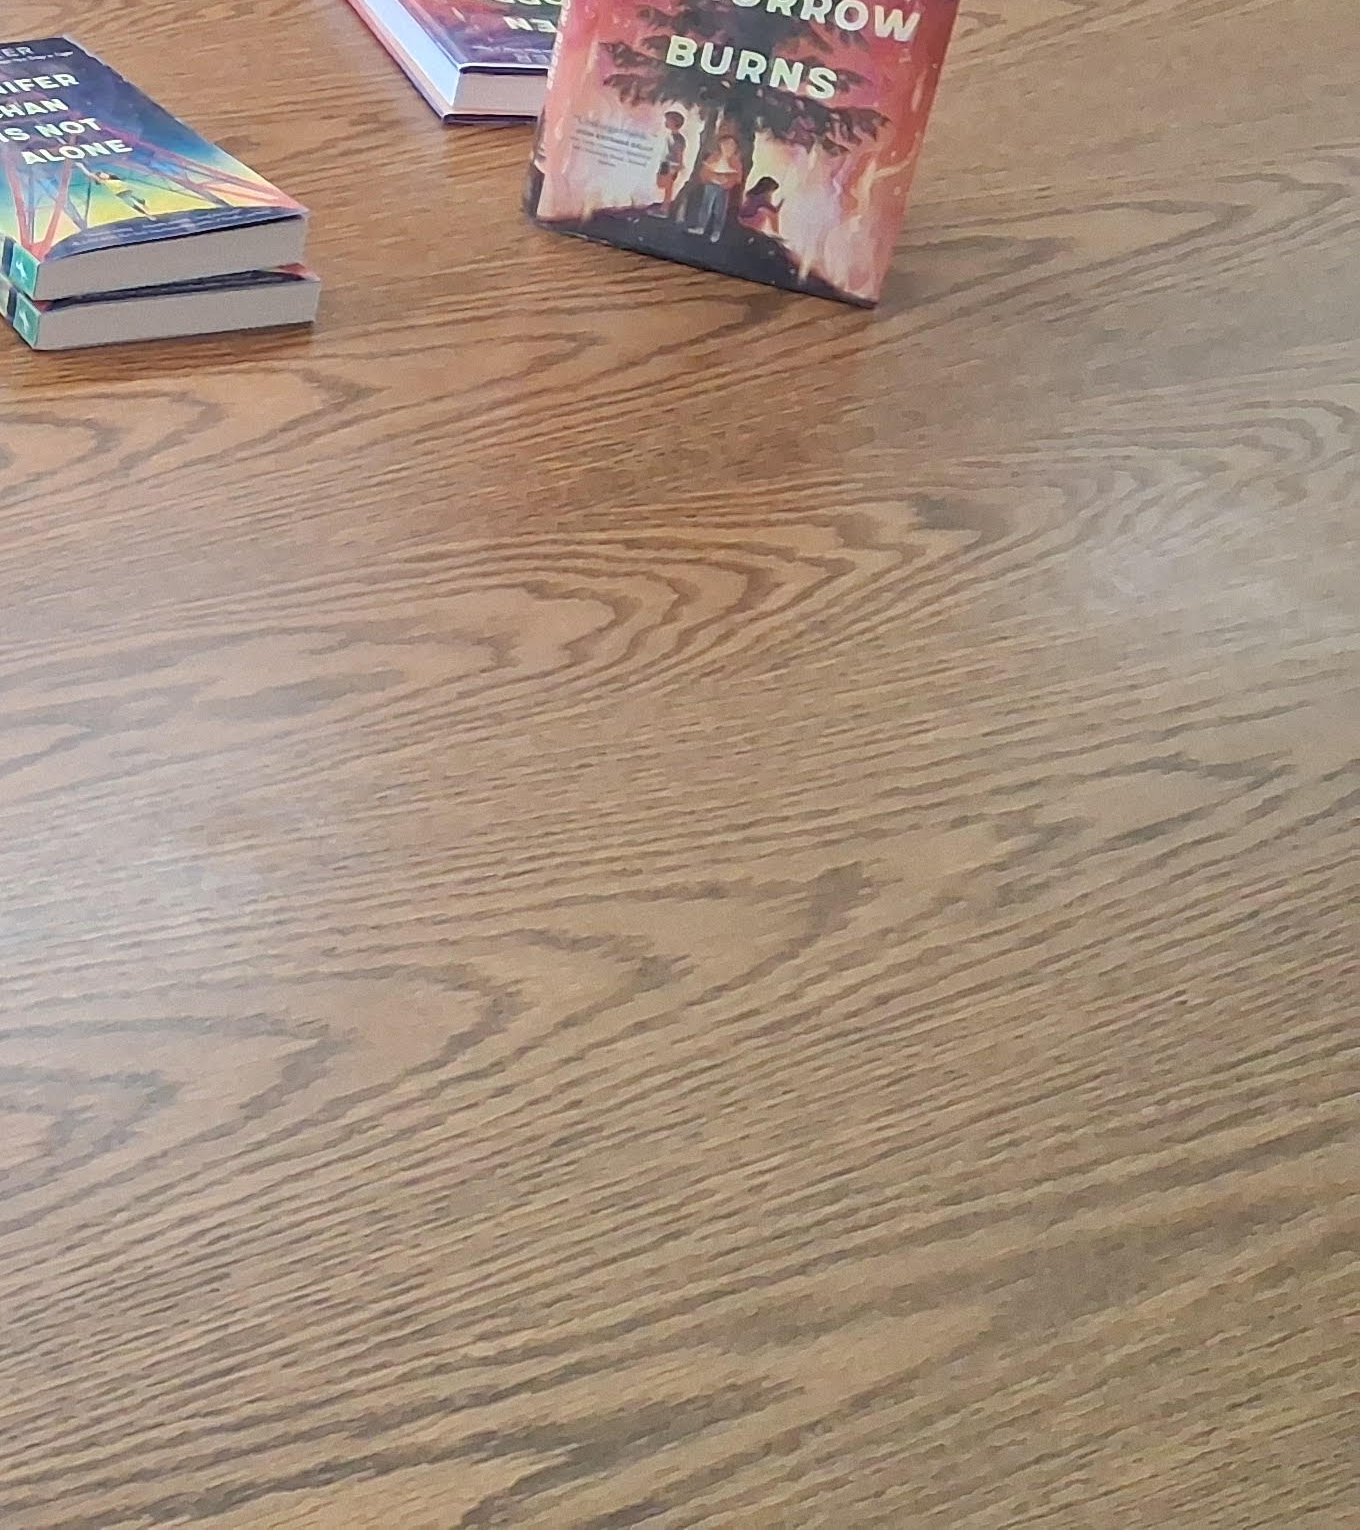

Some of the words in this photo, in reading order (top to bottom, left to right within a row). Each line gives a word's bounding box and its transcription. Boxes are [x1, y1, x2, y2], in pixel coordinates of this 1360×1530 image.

[664, 35, 839, 101] BURNS
[35, 117, 101, 139] NOT
[20, 139, 133, 166] ALONE
